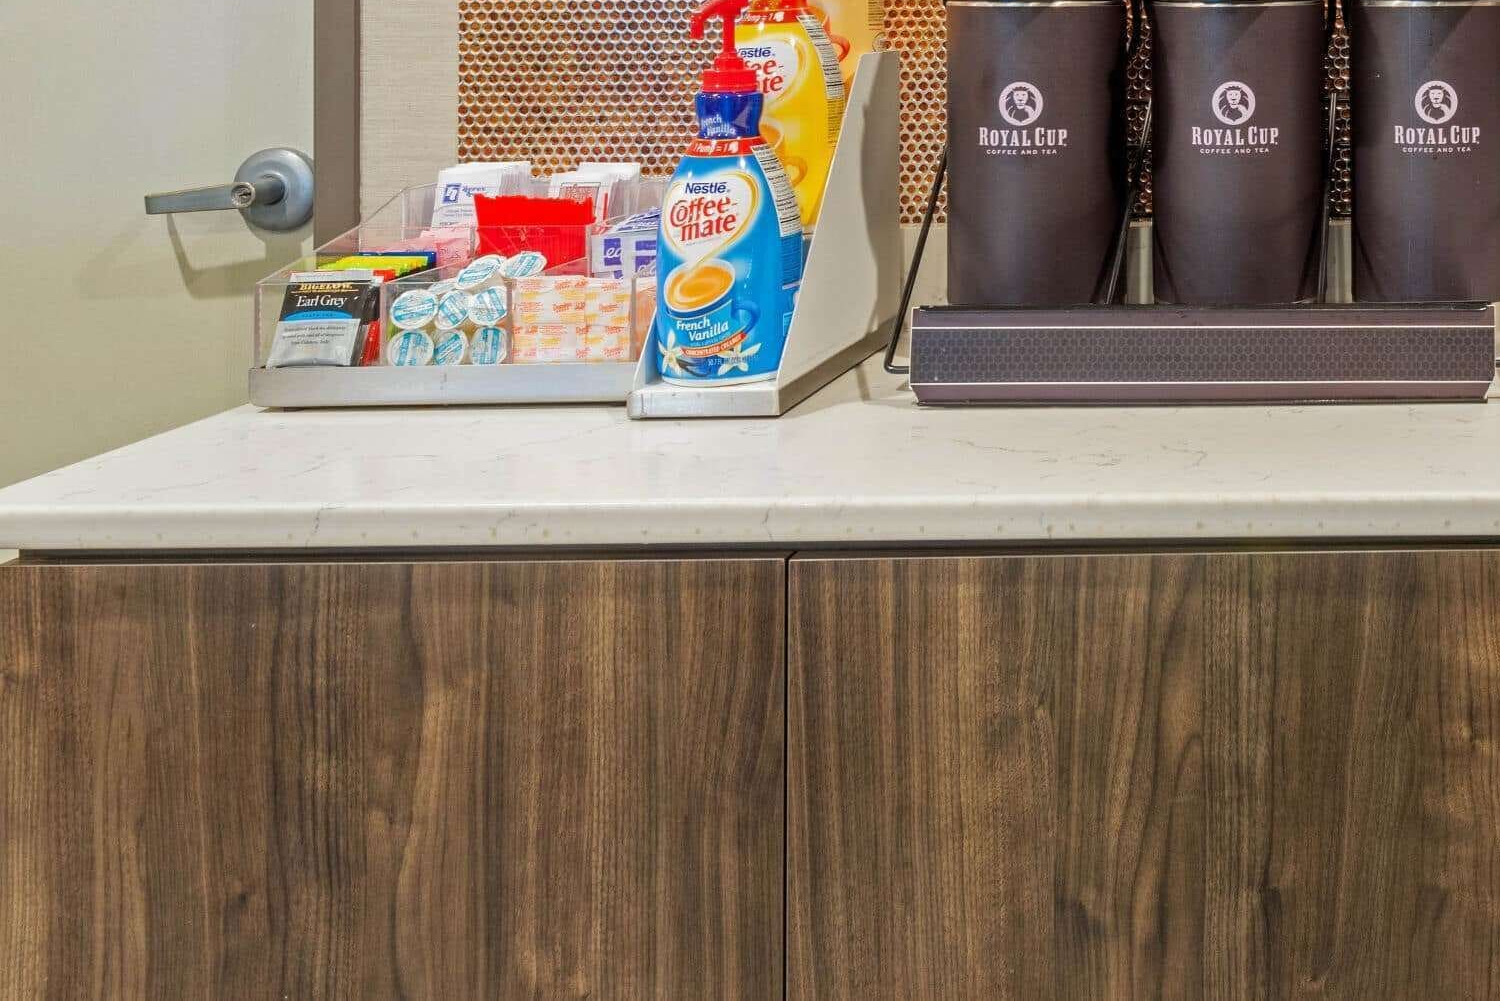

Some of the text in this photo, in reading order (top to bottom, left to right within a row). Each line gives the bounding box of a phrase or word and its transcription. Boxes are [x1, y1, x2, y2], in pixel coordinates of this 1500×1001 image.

[979, 126, 1068, 147] ROYAL CUP
[1192, 125, 1279, 146] ROYAL CUP
[1394, 125, 1480, 145] ROYAL CUP
[680, 213, 737, 242] mate
[296, 294, 347, 308] Earl Grey
[676, 316, 711, 331] French
[689, 320, 729, 341] Vanilla
